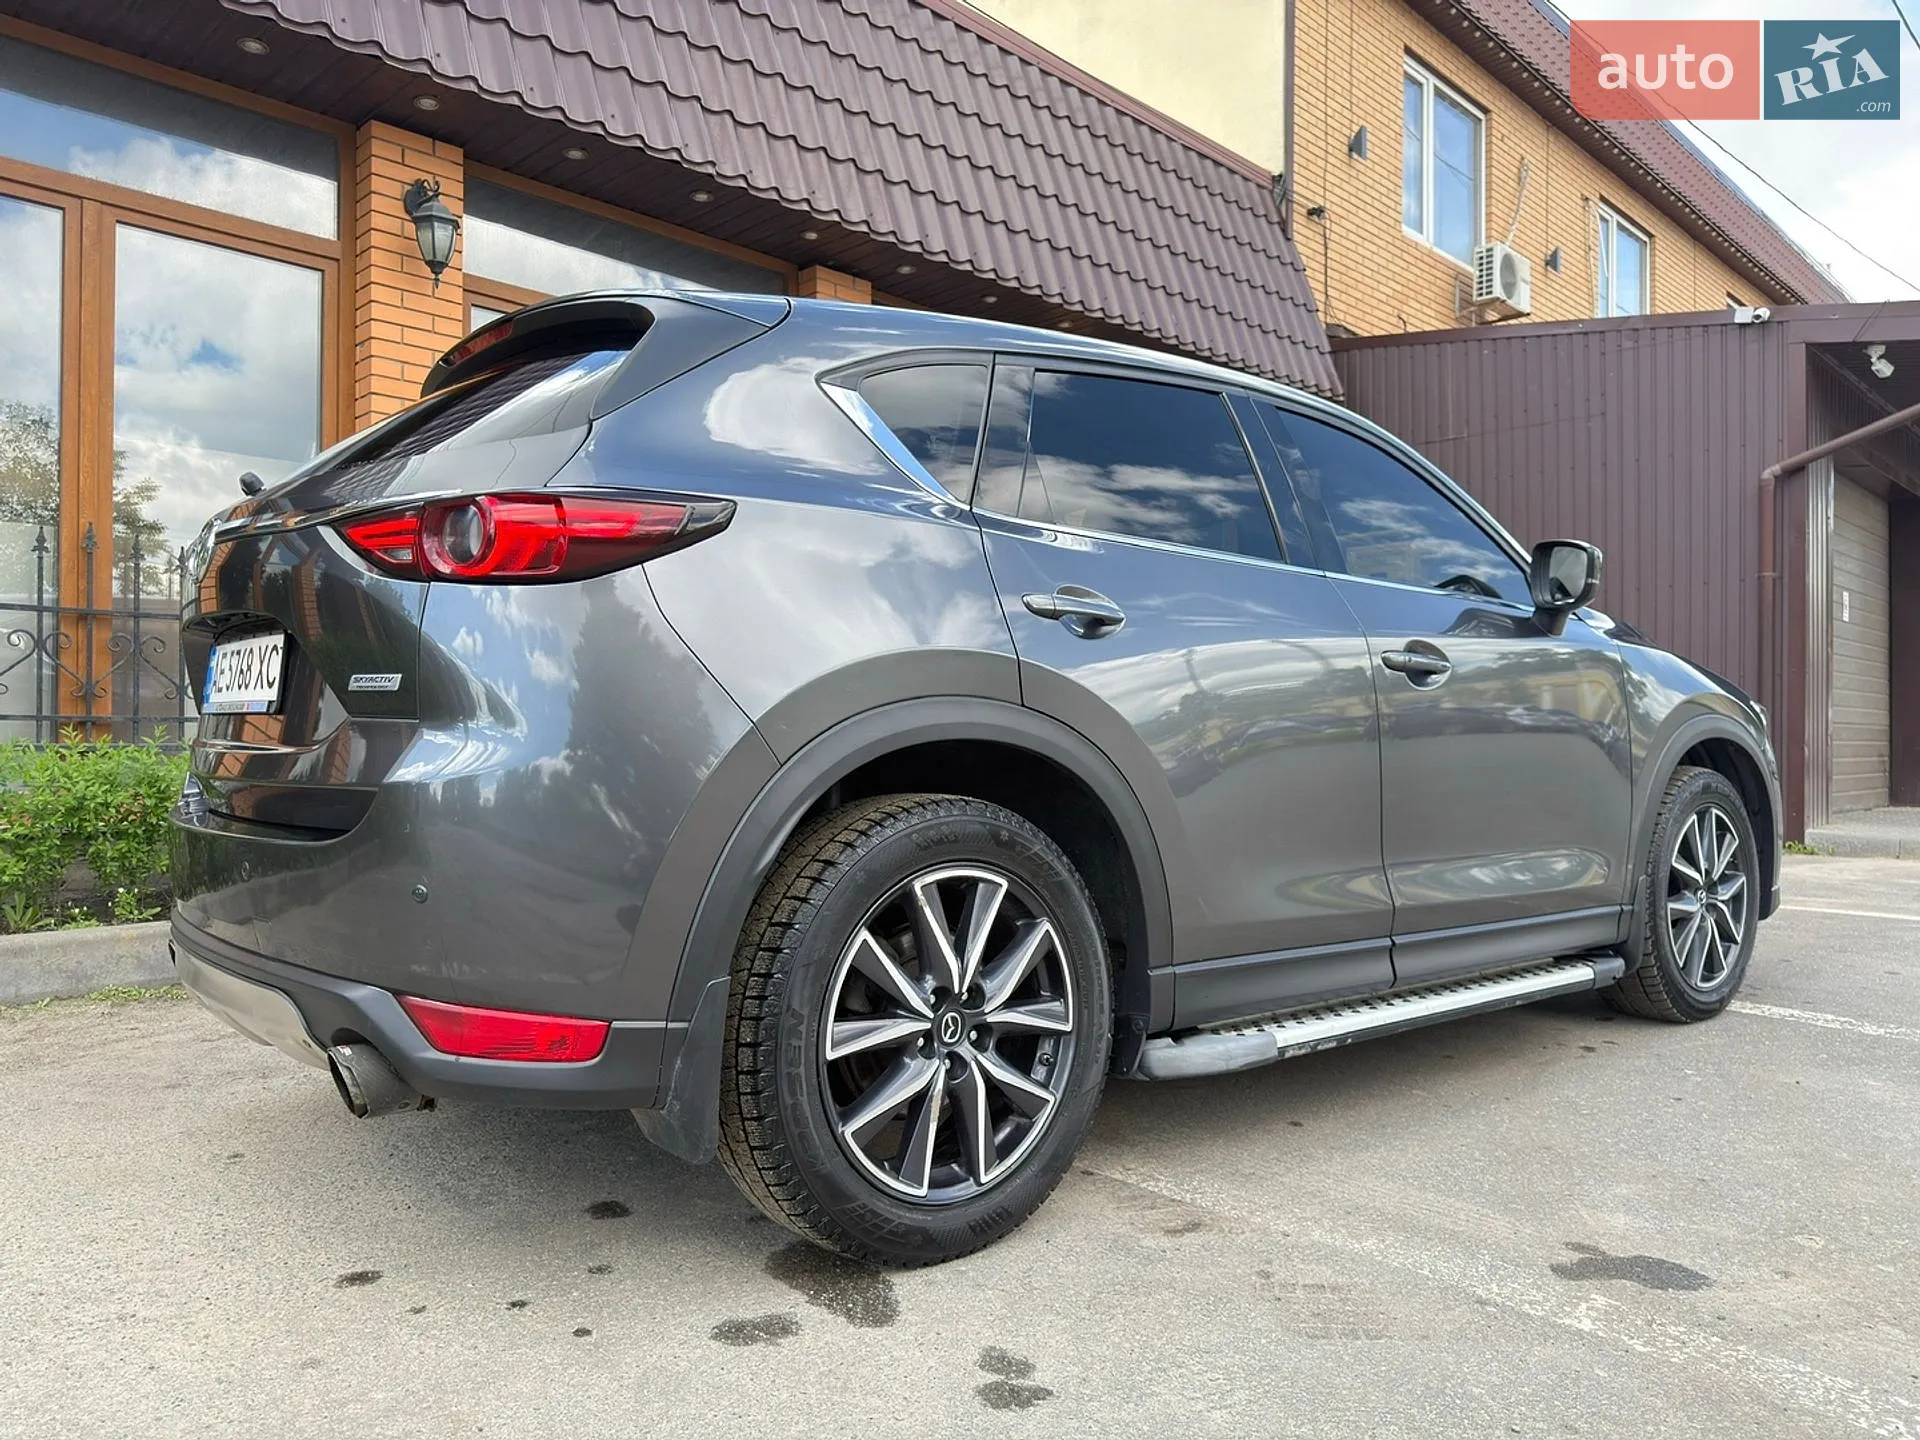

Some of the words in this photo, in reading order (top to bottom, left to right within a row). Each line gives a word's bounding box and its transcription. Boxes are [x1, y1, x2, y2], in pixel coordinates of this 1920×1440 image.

[226, 647, 254, 692] 5768
[254, 644, 279, 691] XC
[352, 676, 395, 684] SKYACTIV
